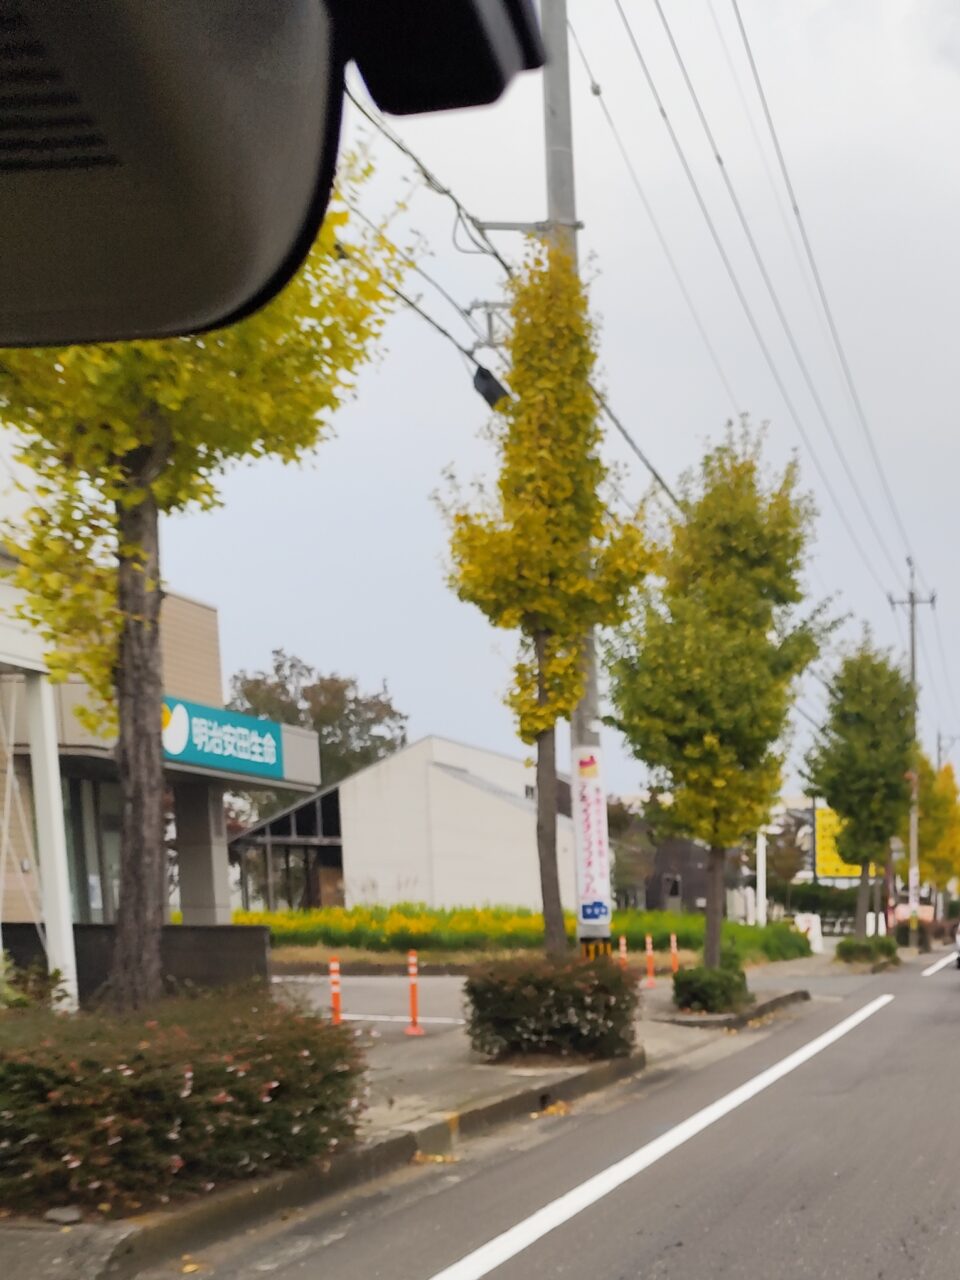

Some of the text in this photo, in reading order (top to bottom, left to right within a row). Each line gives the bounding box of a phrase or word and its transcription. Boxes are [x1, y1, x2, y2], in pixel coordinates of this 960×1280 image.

[191, 717, 276, 764] 明治安田生命
